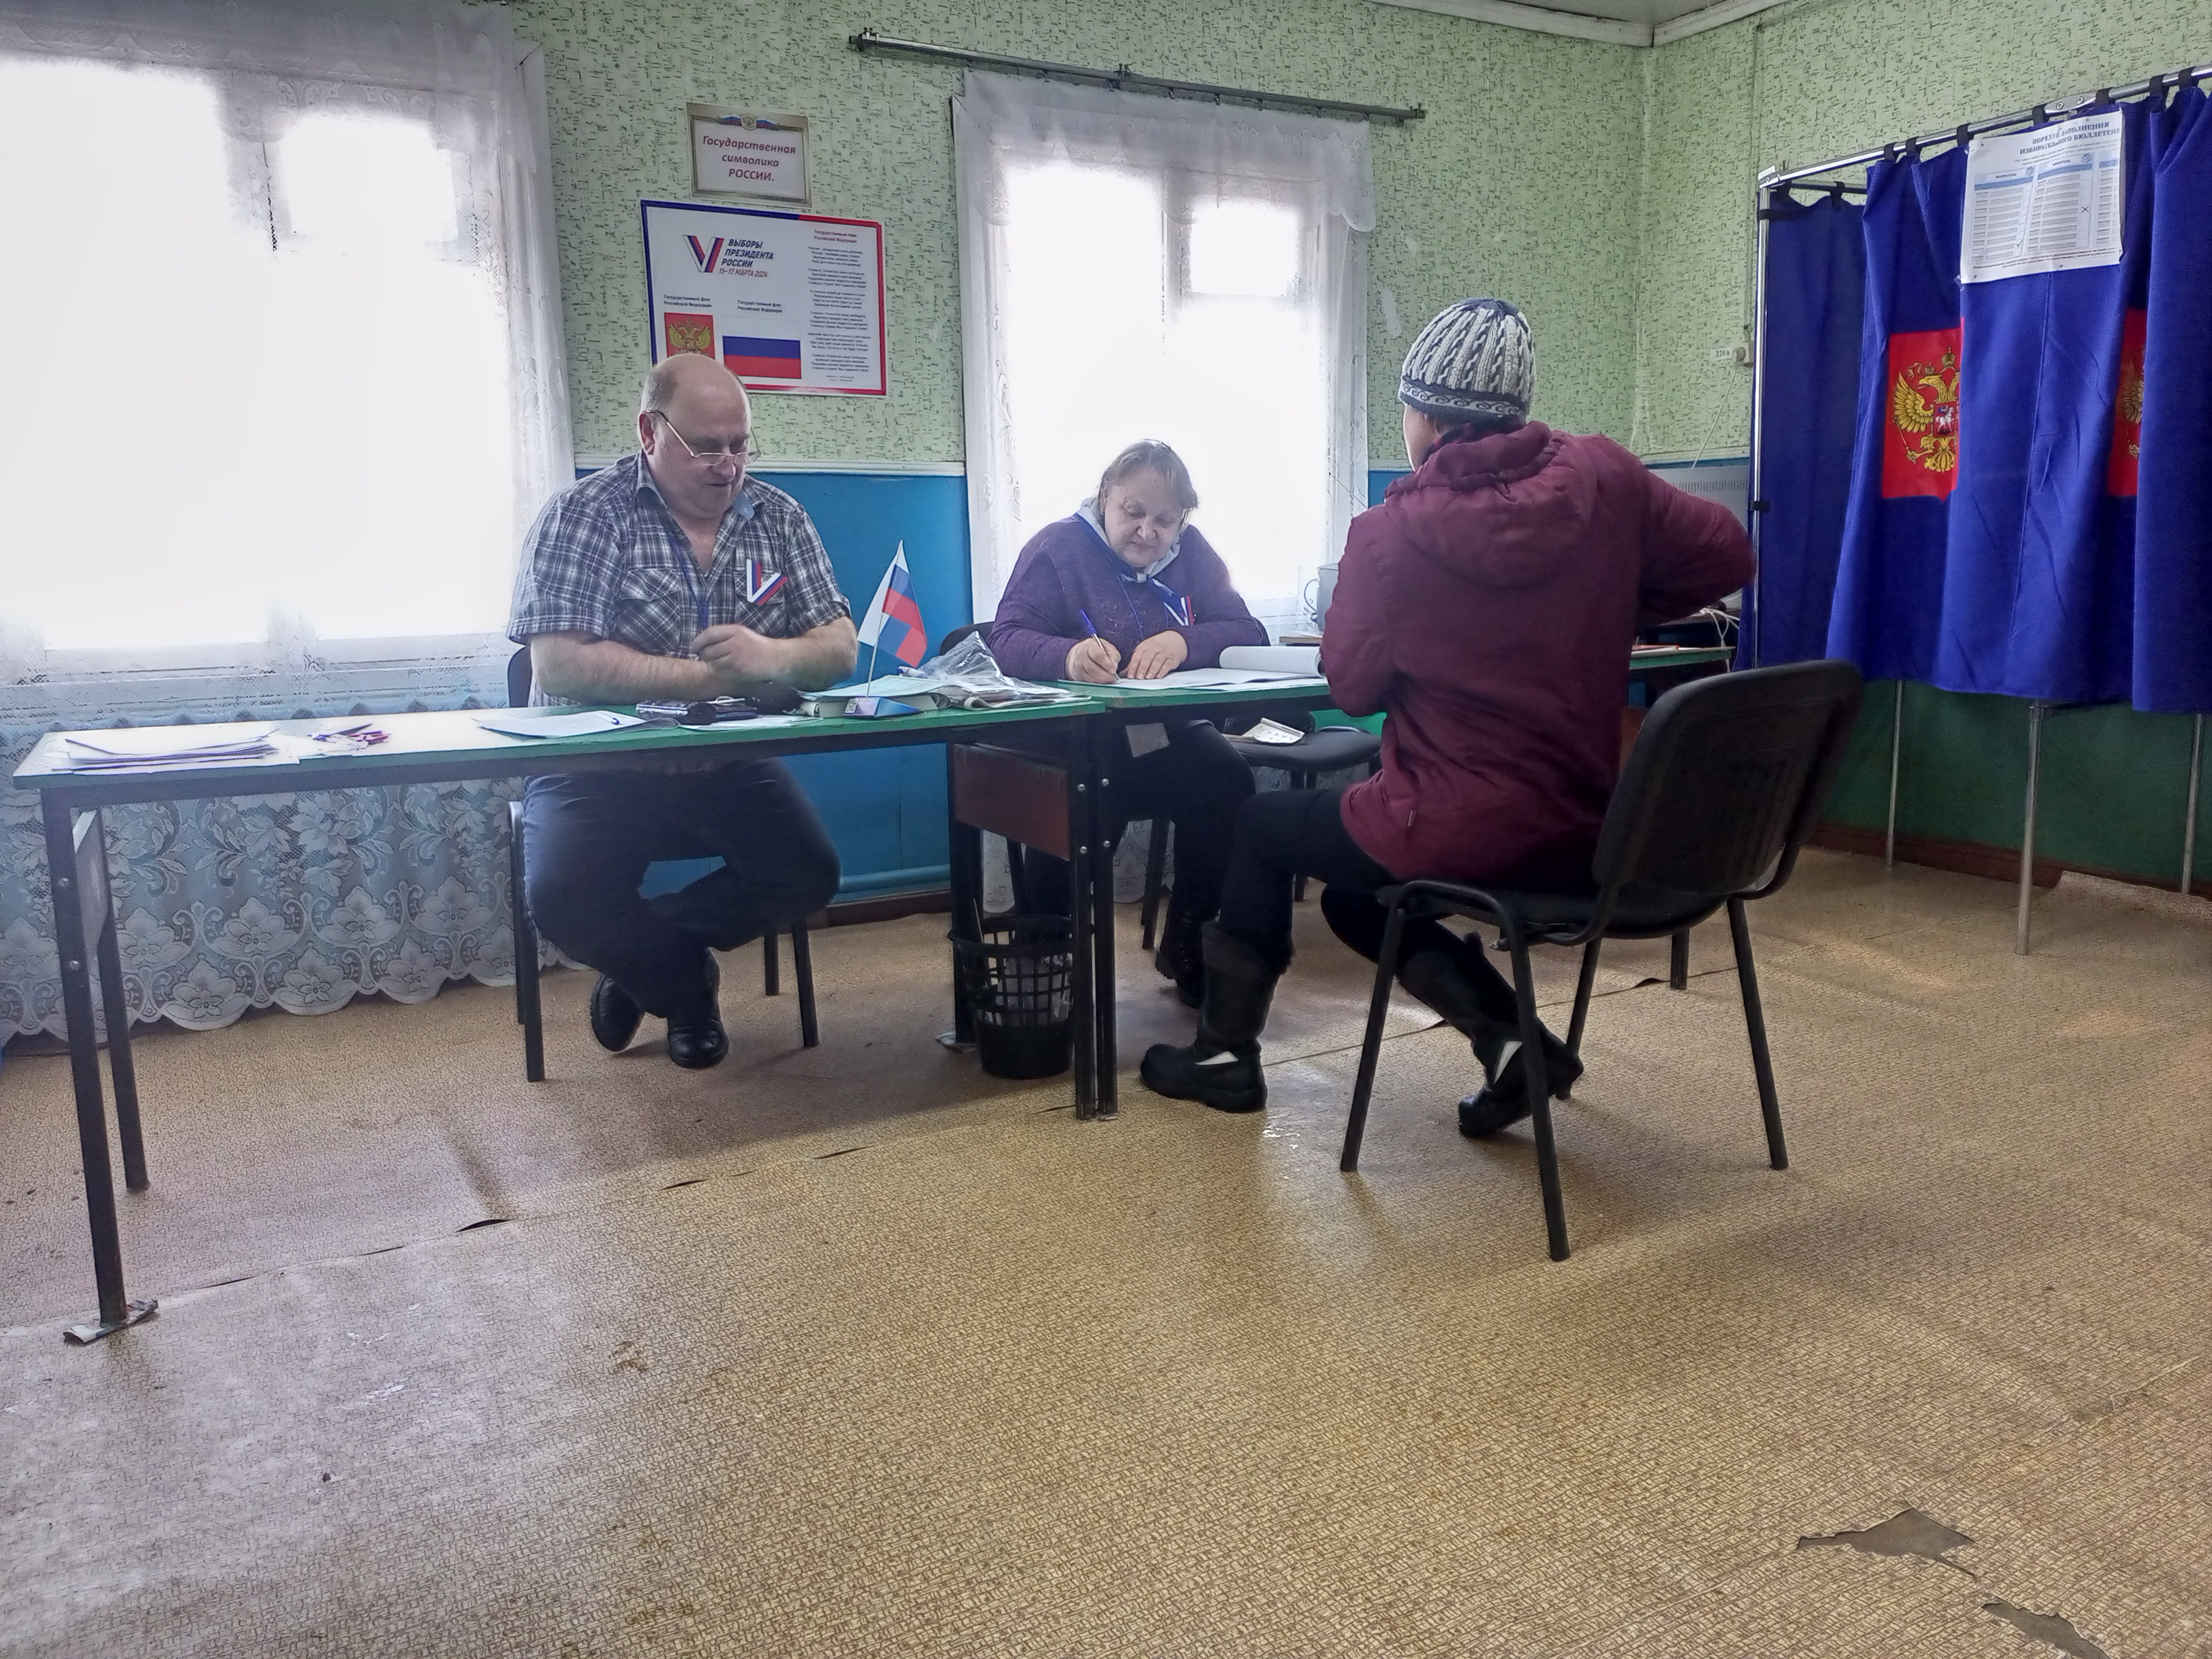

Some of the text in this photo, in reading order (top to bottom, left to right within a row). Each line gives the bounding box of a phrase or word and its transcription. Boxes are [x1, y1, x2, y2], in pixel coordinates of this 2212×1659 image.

[2073, 128, 2120, 140] БЮЛЛЕТЕНЯ
[702, 135, 796, 154] Государственная
[722, 154, 779, 167] символика
[729, 168, 774, 181] РОССИИ.
[728, 239, 763, 249] ВЫБОРЫ
[725, 249, 774, 260] ПРЕЗИДЕНТА
[721, 259, 753, 268] РОССИИ
